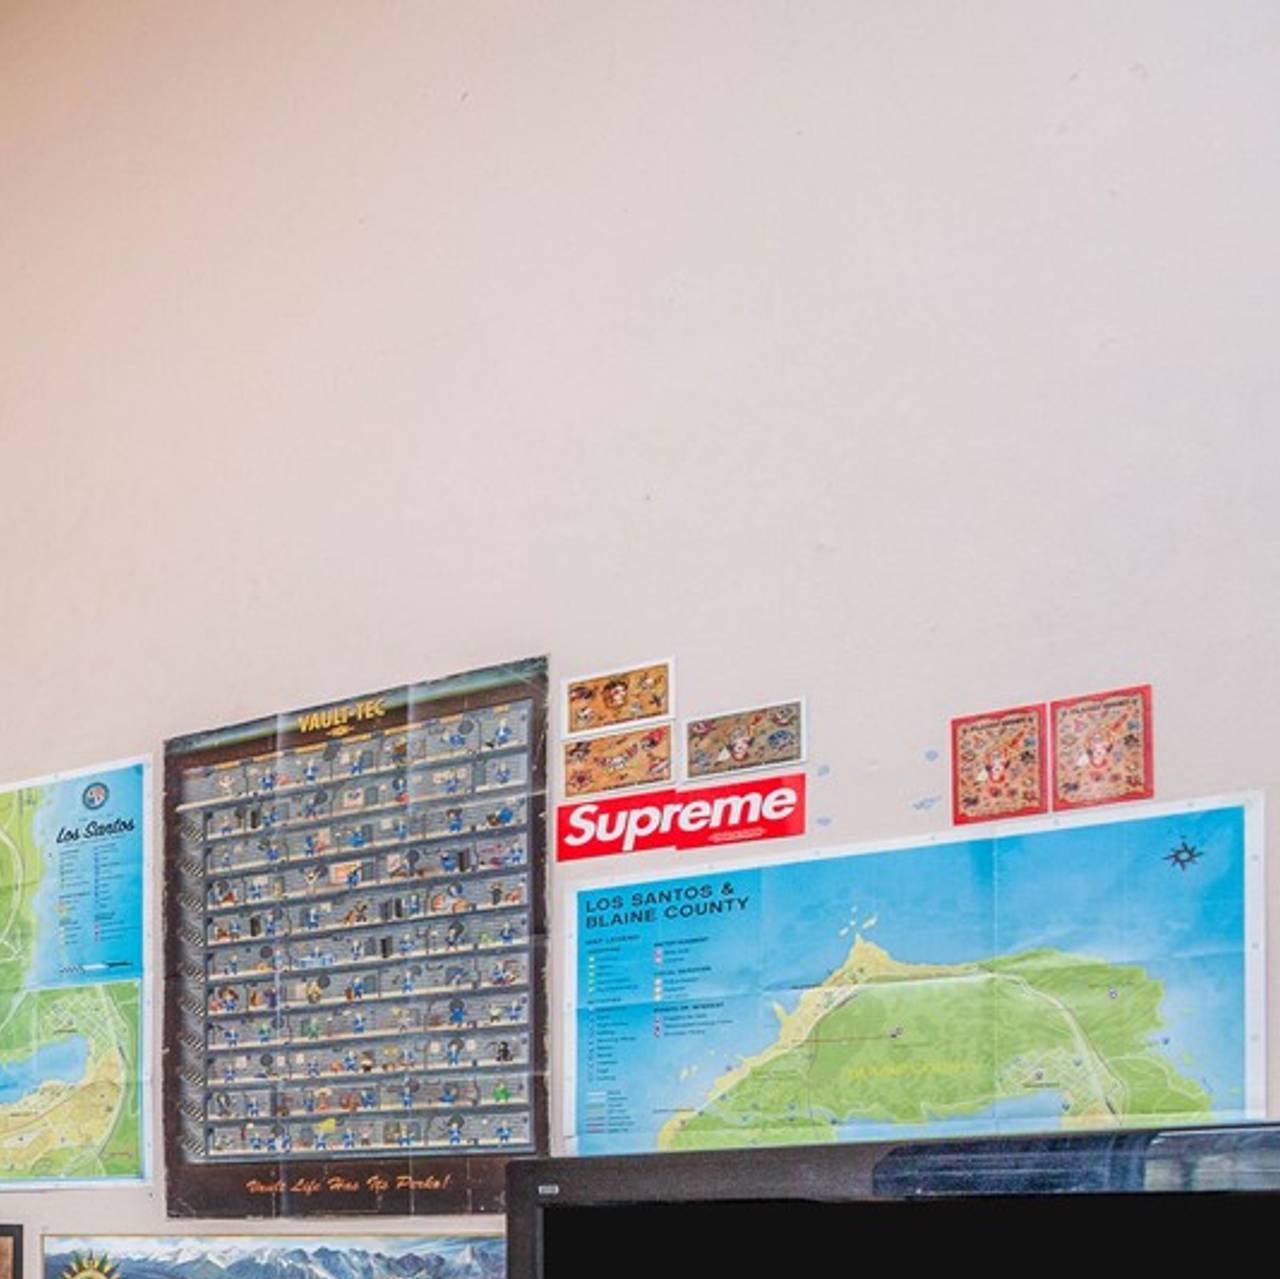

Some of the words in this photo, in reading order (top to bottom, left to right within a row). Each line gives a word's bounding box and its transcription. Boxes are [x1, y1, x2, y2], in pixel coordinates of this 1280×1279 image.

[298, 698, 386, 733] VAULT-TEC
[56, 825, 80, 844] Los
[83, 818, 135, 839] Santos
[564, 787, 798, 852] Supreme
[586, 895, 624, 913] LOS
[632, 884, 713, 908] SANTOS
[721, 881, 734, 896] &
[586, 909, 656, 929] BLAINE
[664, 897, 749, 919] COUNTY
[246, 1178, 286, 1193] Vault
[290, 1178, 321, 1195] Life
[327, 1176, 360, 1191] Has
